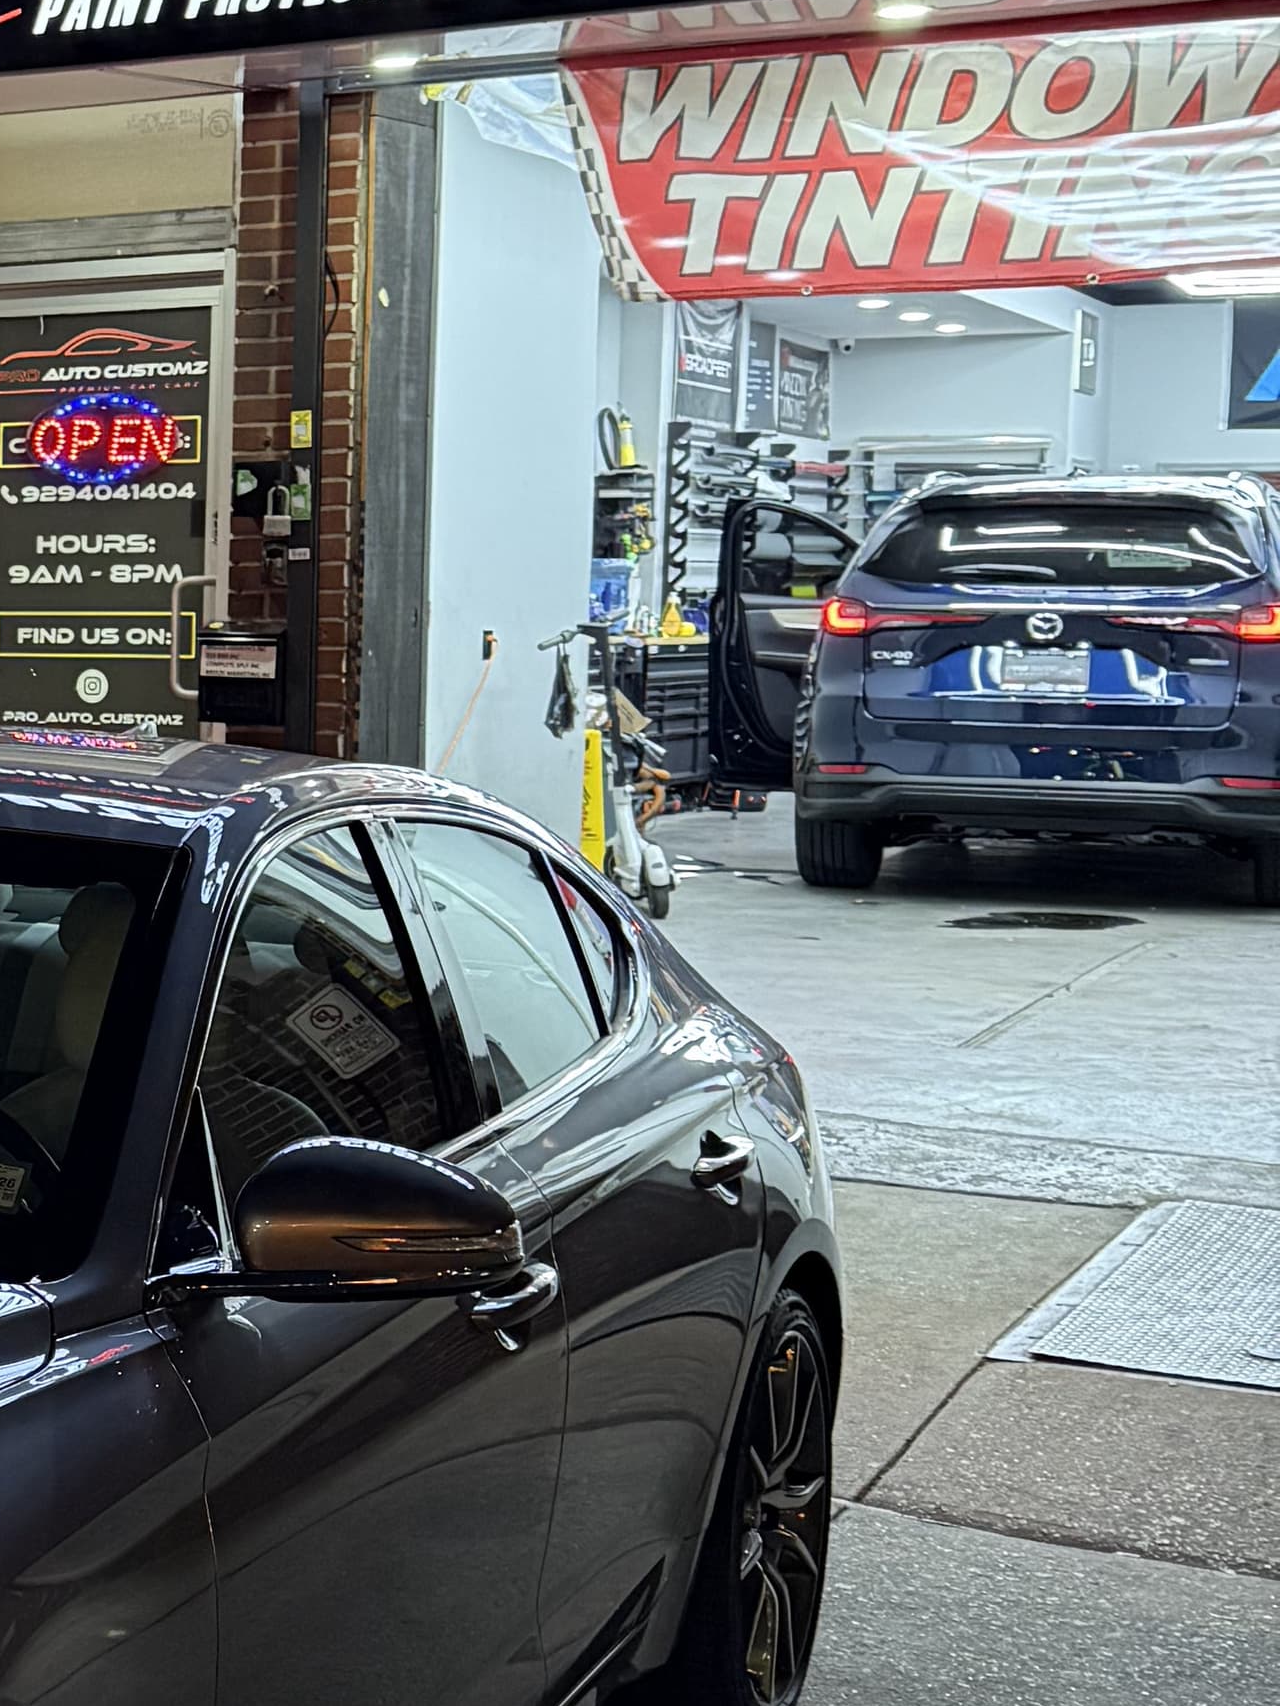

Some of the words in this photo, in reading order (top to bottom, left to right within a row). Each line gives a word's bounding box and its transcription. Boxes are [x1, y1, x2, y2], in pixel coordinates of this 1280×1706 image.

[618, 28, 1280, 163] WINDOW
[41, 365, 101, 382] AUTO
[103, 361, 208, 378] CUSTOMZ
[33, 416, 176, 464] OPEN
[21, 482, 197, 502] 9294041404
[36, 534, 157, 554] HOURS:
[8, 564, 83, 584] 9AM
[109, 564, 184, 583] 8PM
[17, 627, 75, 644] FIND
[81, 628, 120, 644] US
